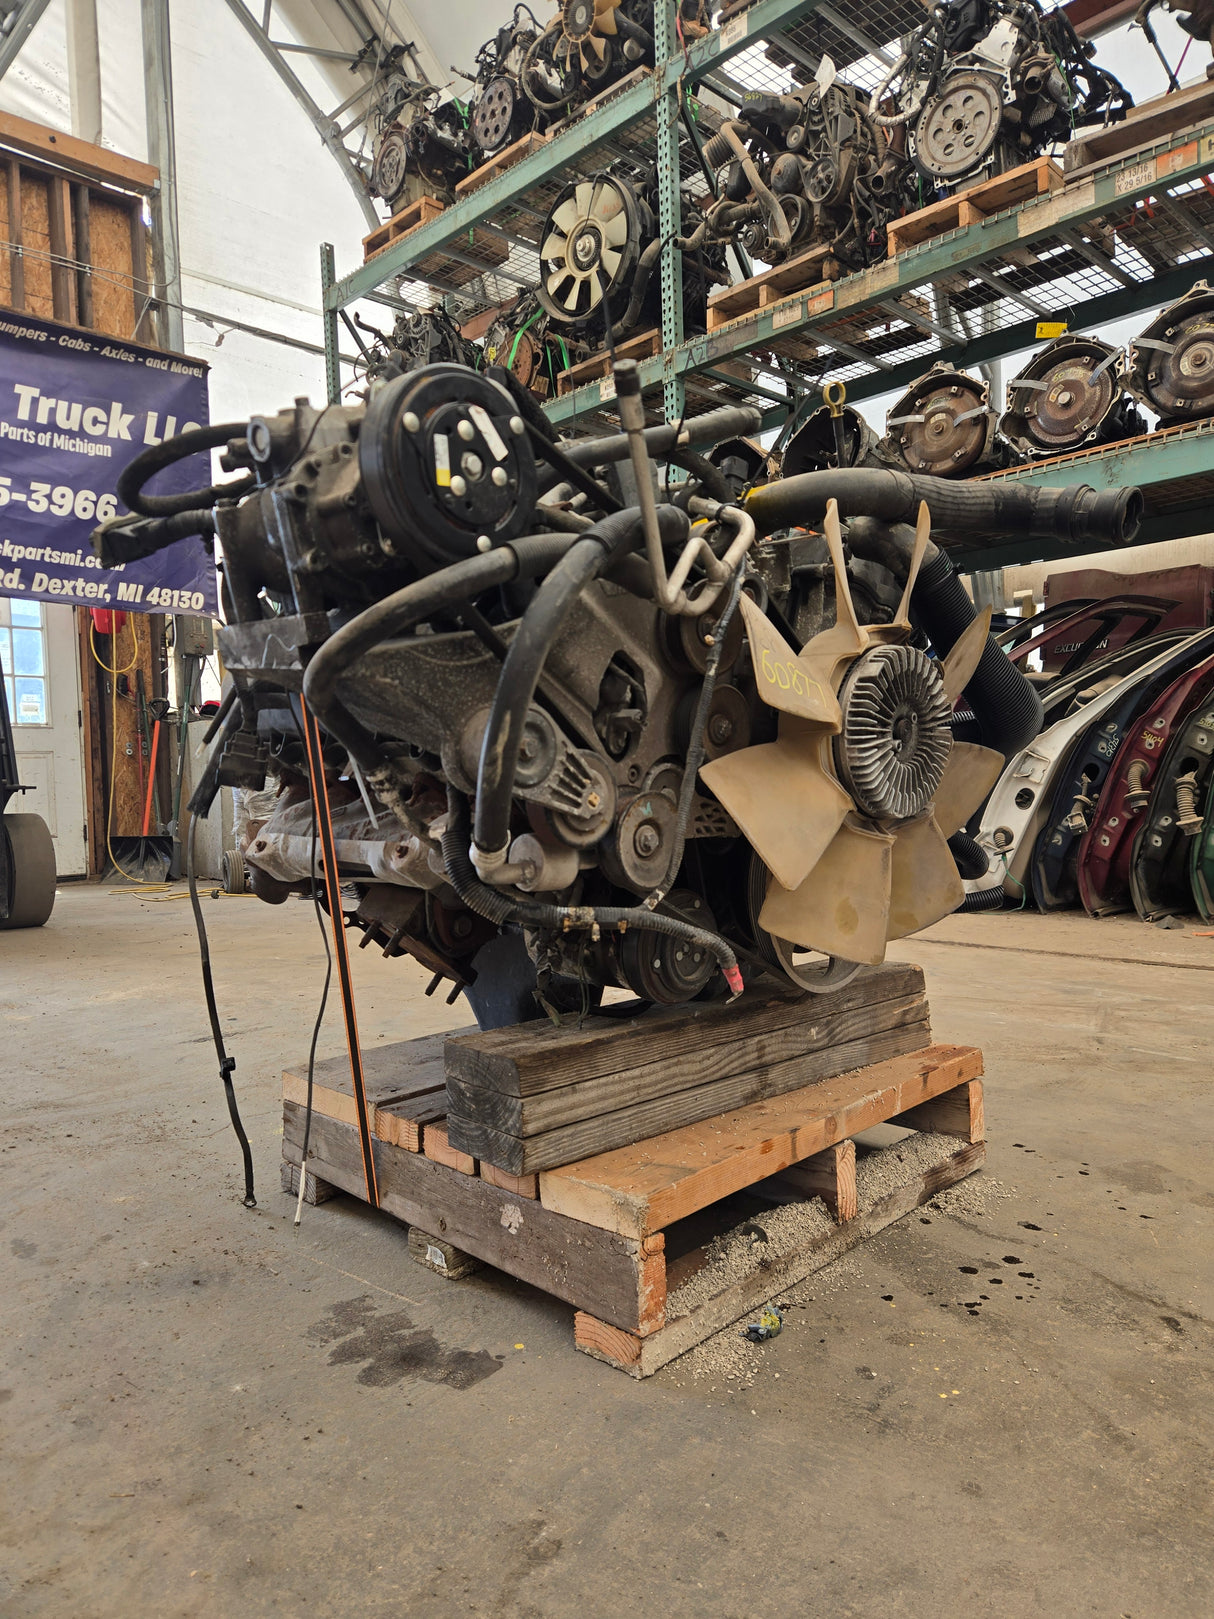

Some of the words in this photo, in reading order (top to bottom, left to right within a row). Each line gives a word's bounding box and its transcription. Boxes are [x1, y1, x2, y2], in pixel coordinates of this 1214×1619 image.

[1116, 172, 1126, 183] 23
[1128, 163, 1149, 179] 13/16
[1124, 181, 1134, 191] 29
[1135, 172, 1152, 186] 5/16
[58, 335, 92, 352] Cabs
[101, 345, 136, 363] Axles
[146, 357, 168, 371] and
[170, 362, 203, 378] More!
[14, 384, 136, 441] Truck
[1, 422, 36, 444] Parts
[37, 431, 53, 447] of
[53, 434, 112, 457] Michigan
[31, 573, 111, 603] Dexter,
[117, 582, 144, 603] MI
[146, 586, 204, 610] 48130
[1055, 639, 1108, 654] EXCUN
[762, 649, 827, 709] 60877
